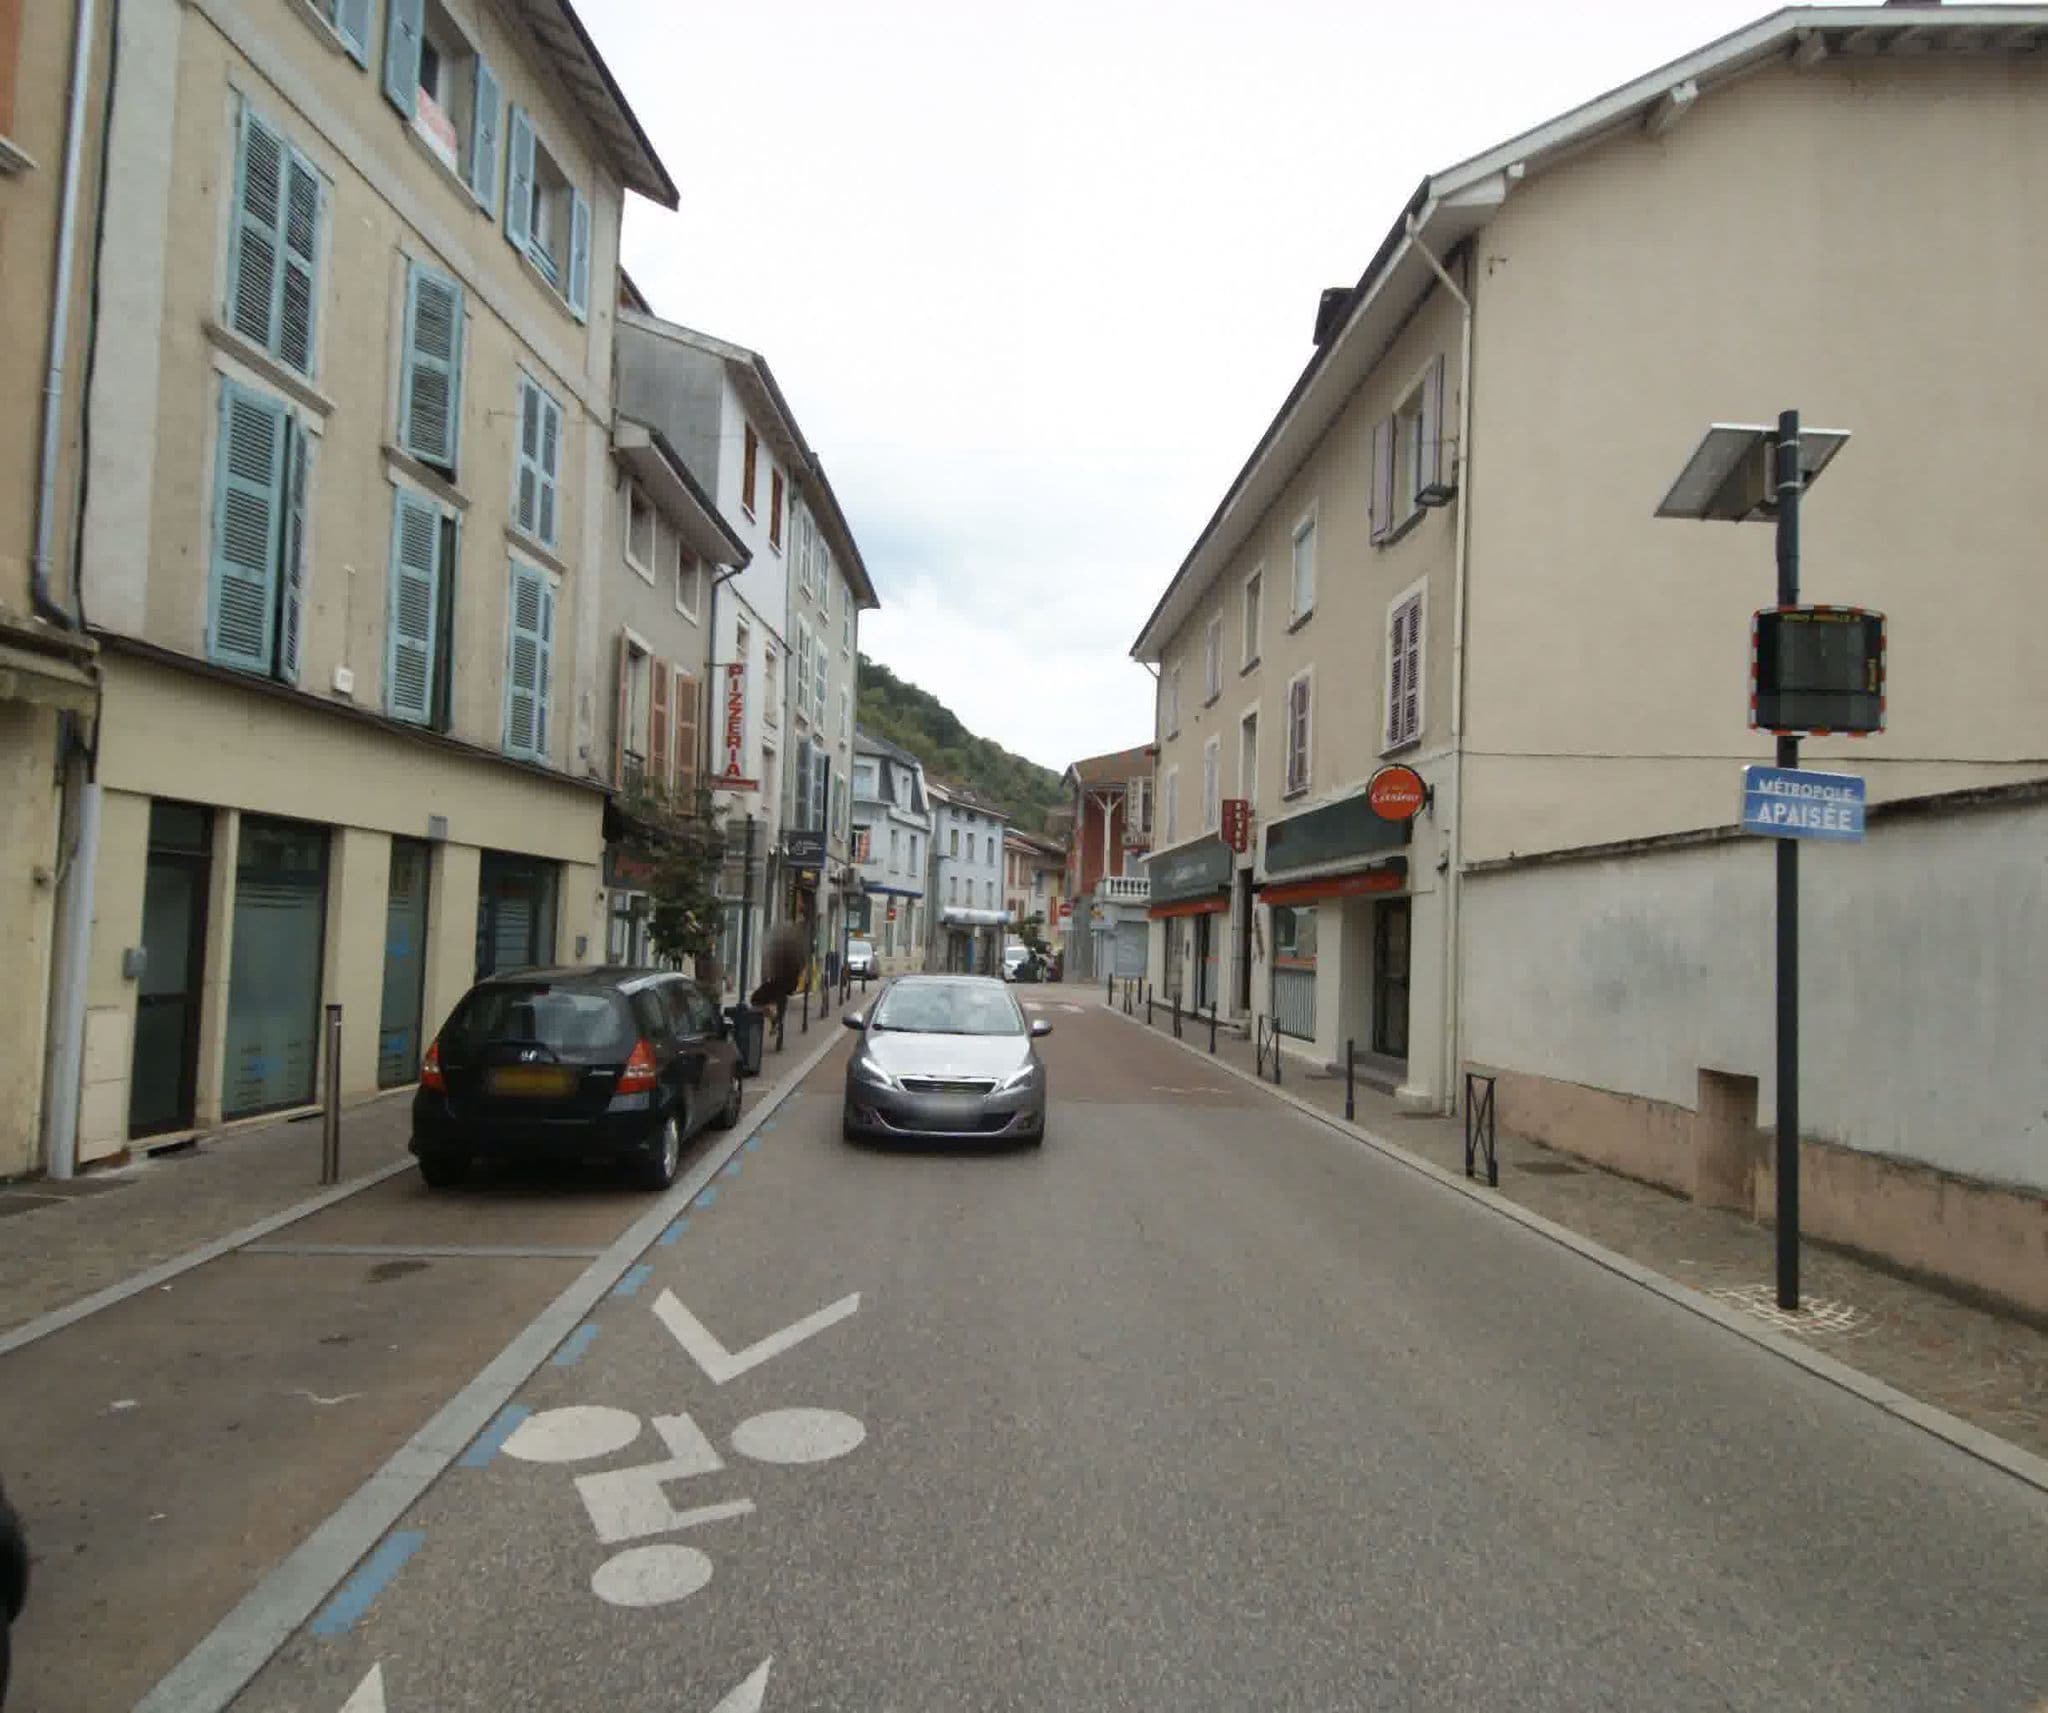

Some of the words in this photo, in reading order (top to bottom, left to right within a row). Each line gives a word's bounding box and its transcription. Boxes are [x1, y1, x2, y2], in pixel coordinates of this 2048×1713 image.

[726, 663, 744, 776] PIZZERIA
[1759, 777, 1855, 799] MÉTROPOLE
[1758, 802, 1851, 830] APAISÉE
